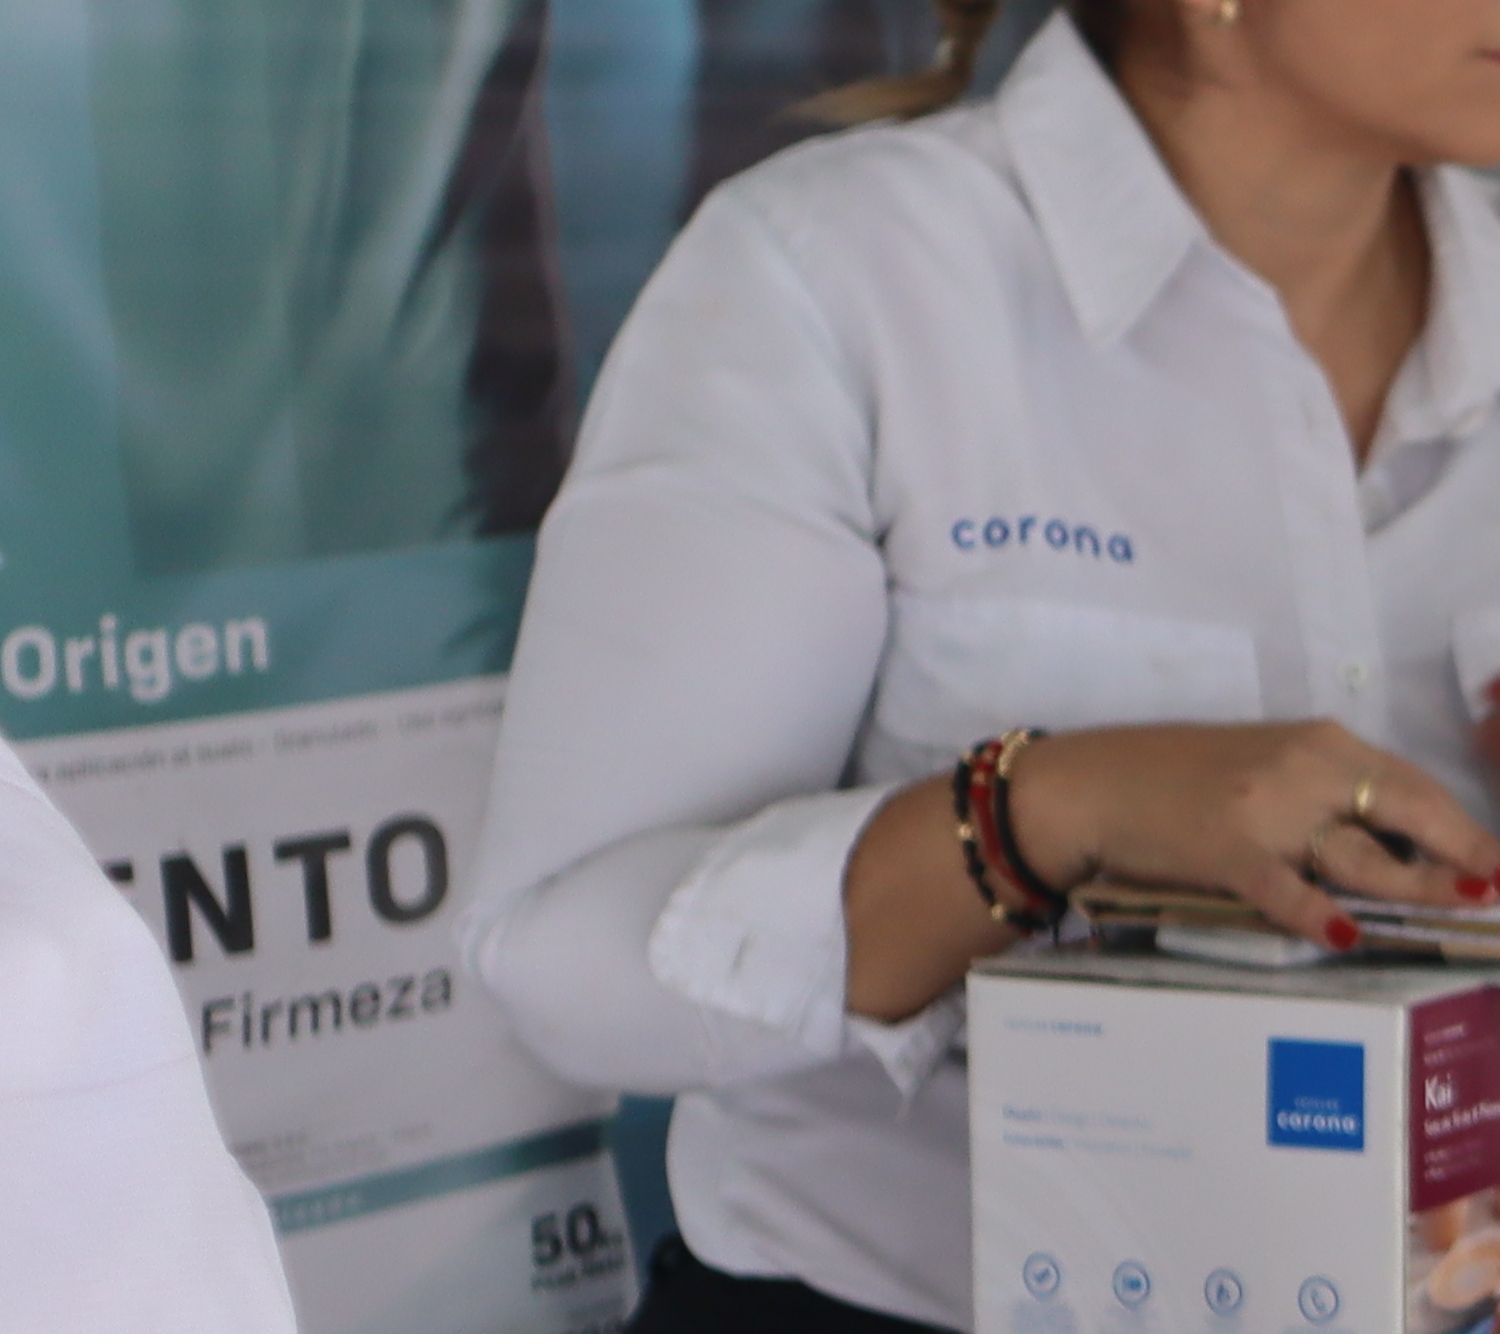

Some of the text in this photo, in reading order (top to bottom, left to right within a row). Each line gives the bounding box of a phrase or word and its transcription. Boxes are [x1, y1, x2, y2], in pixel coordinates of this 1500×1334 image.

[951, 512, 1136, 565] corona
[2, 614, 271, 706] Origen
[202, 965, 454, 1059] Firmeza
[1277, 1110, 1357, 1135] corona
[531, 1201, 602, 1270] 50
